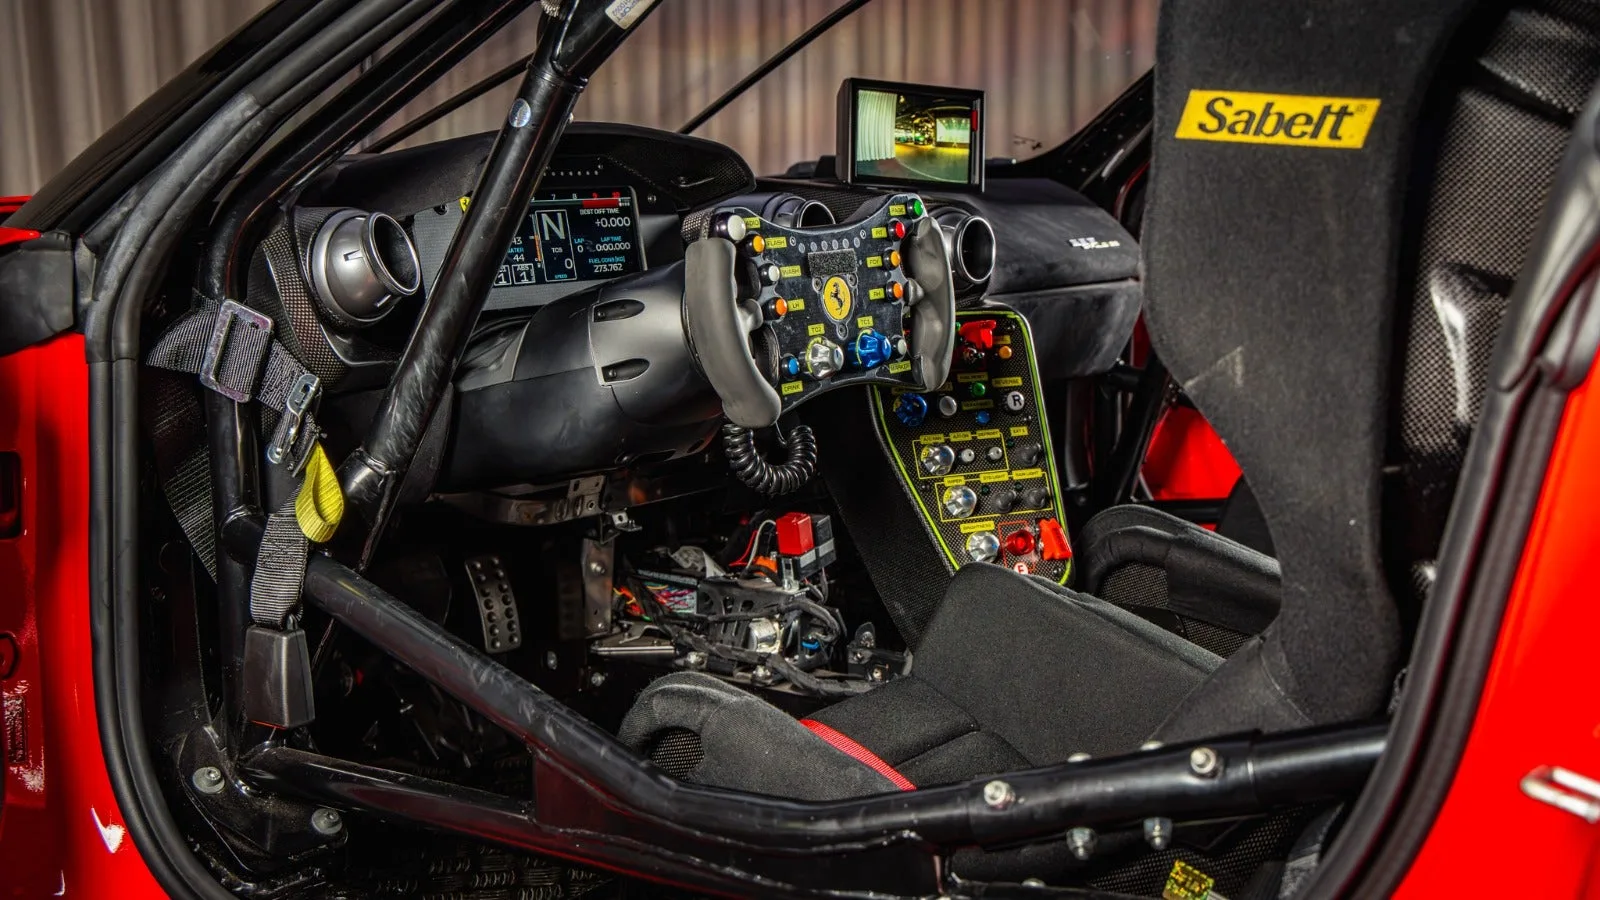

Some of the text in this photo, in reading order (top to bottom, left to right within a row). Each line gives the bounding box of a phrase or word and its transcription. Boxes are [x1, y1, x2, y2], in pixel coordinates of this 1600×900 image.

[1198, 97, 1354, 141] Sabelt
[541, 212, 566, 241] N
[595, 216, 631, 228] +0.000
[596, 242, 631, 252] 0:00.000
[767, 239, 786, 247] FLASH
[577, 245, 584, 253] 0
[512, 253, 525, 262] 44
[564, 258, 573, 270] 0
[593, 263, 624, 273] 273.762
[520, 271, 529, 282] 1
[782, 268, 800, 276] WASH
[498, 273, 507, 284] 1
[994, 378, 1019, 386] REVERSE
[783, 385, 801, 393] DRINK
[1012, 394, 1022, 407] R
[1017, 565, 1025, 574] E
